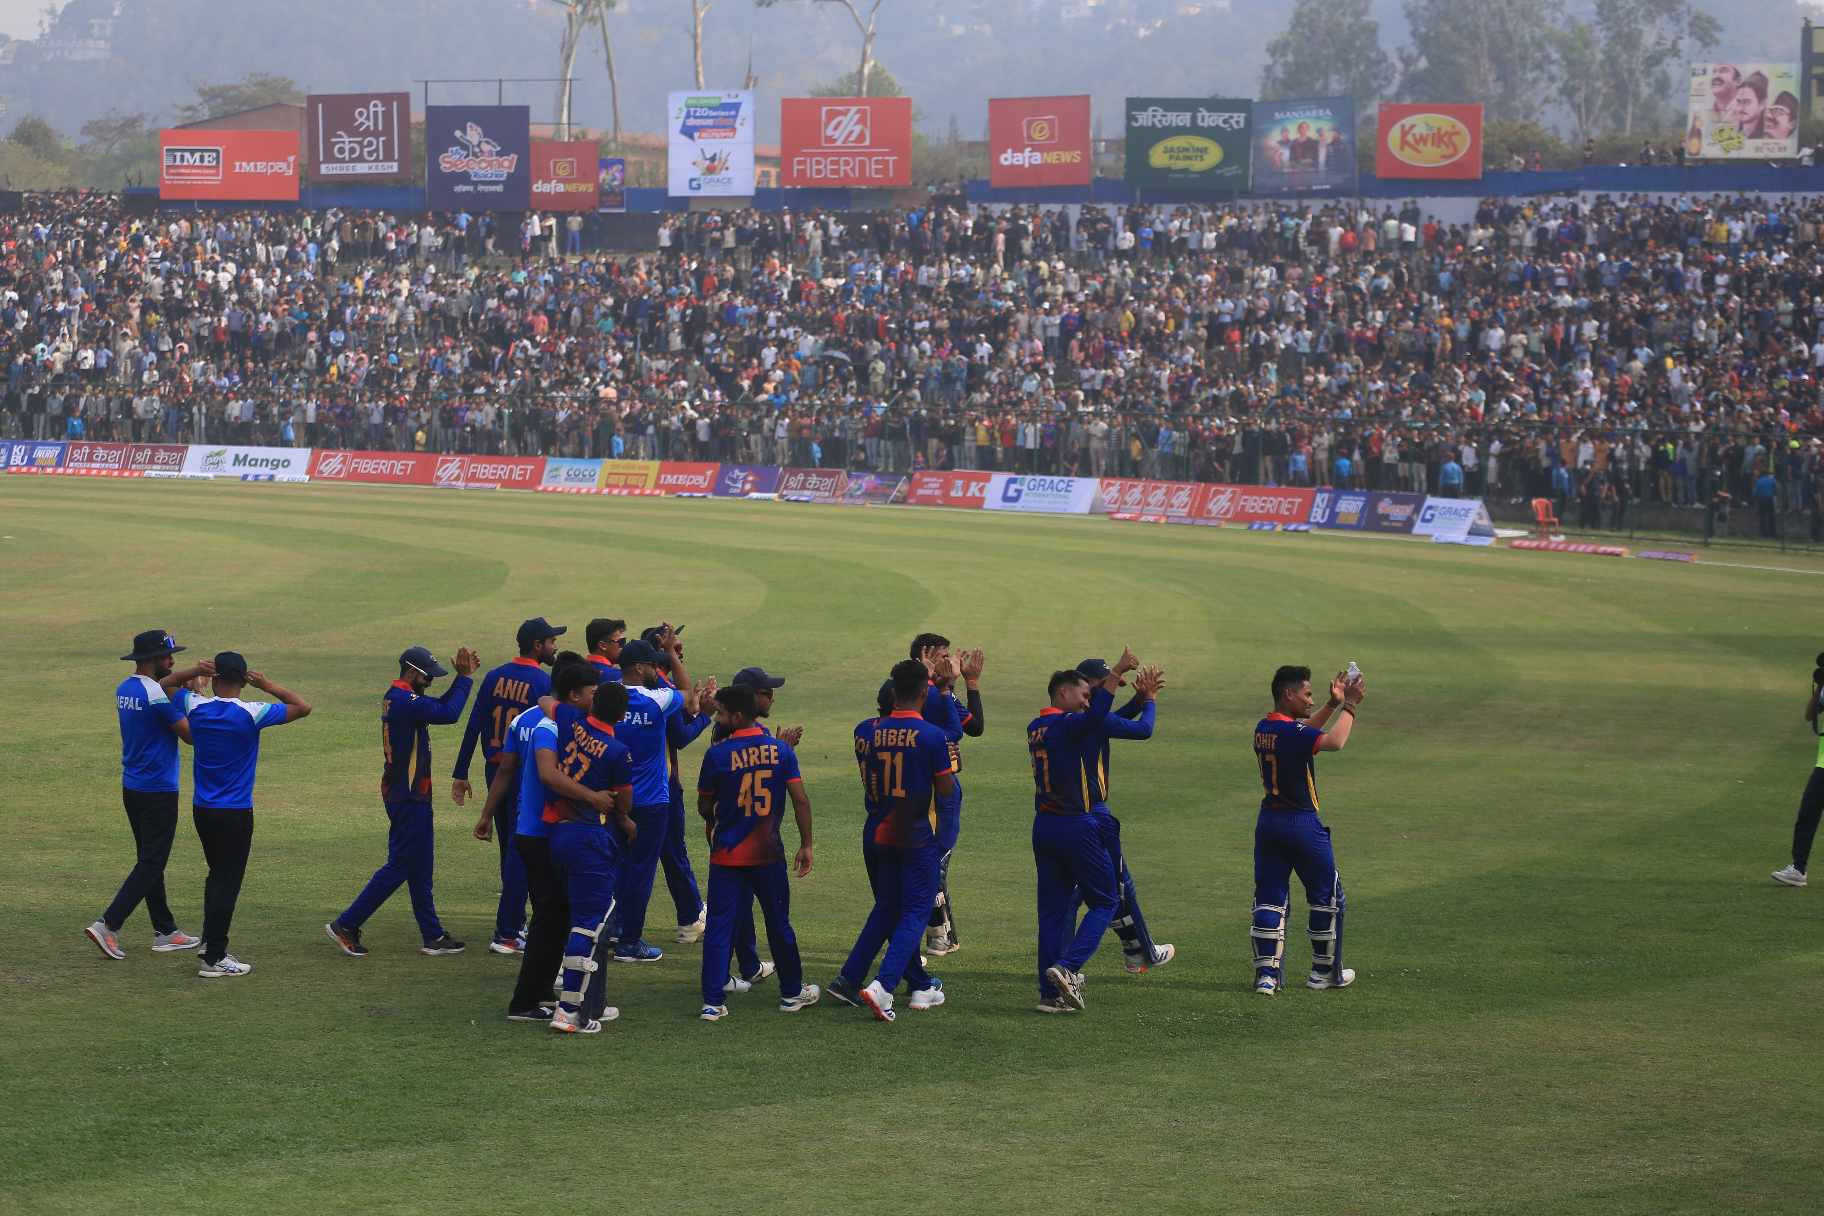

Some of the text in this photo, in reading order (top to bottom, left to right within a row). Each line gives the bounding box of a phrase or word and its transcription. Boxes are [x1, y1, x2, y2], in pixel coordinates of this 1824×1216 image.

[353, 100, 386, 131] श्री
[1131, 106, 1192, 129] जस्मिन
[330, 131, 386, 160] केश
[174, 152, 217, 166] IME
[439, 153, 518, 173] Second
[793, 156, 899, 178] FIBERNET
[71, 446, 122, 463] श्री केश
[135, 448, 152, 464] श्री
[154, 448, 182, 464] केश
[232, 453, 291, 470] Mango
[349, 458, 416, 475] FIBERNET
[468, 463, 535, 480] FIBERNET
[1026, 478, 1075, 493] GRACE
[1238, 496, 1303, 515] FIBERNET
[1439, 505, 1472, 518] GRACE
[492, 676, 530, 705] ANIL
[874, 728, 920, 748] BIBEK
[731, 745, 780, 771] AIREE
[876, 751, 906, 799] 71
[737, 769, 773, 817] 45
